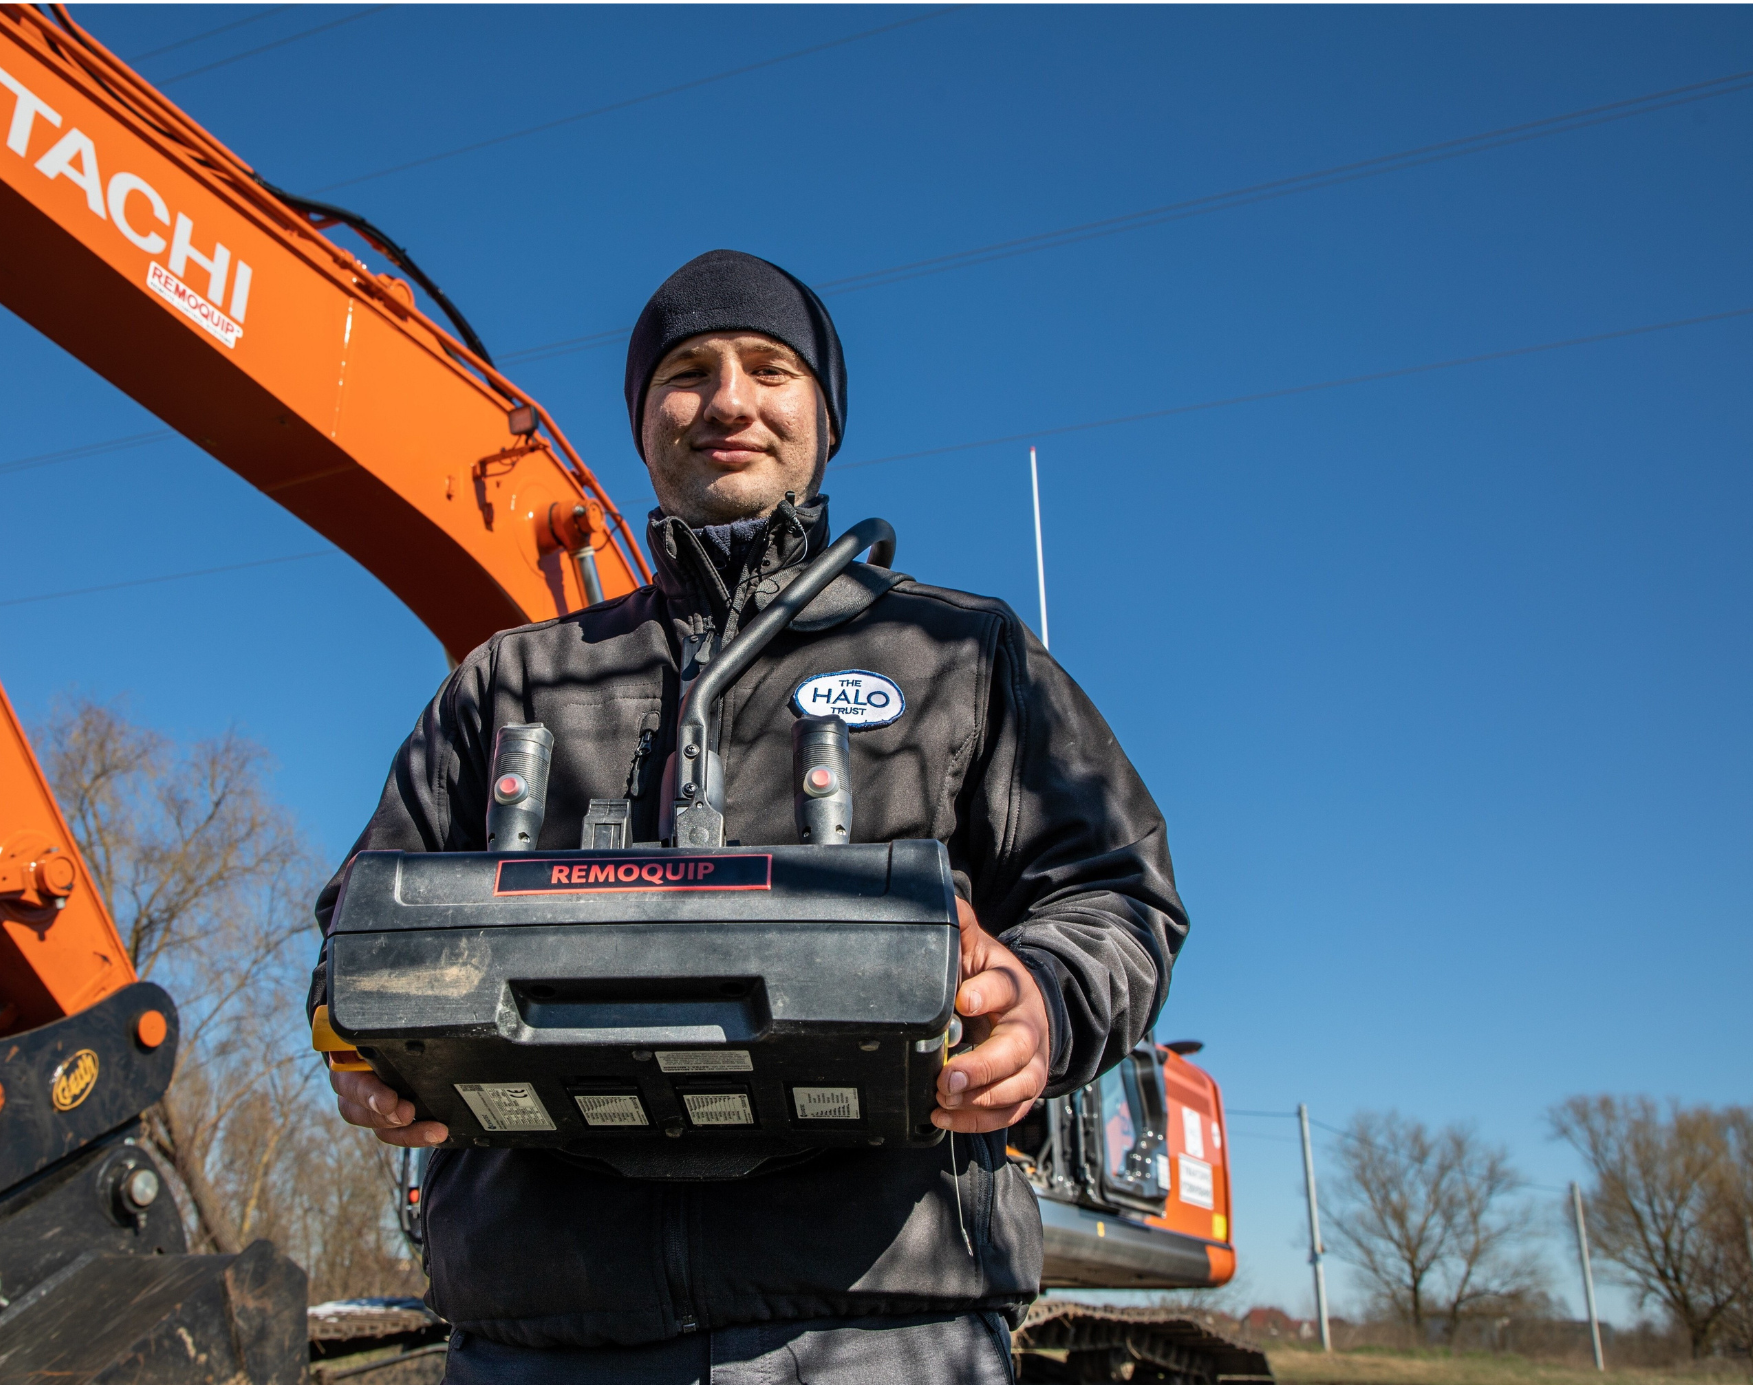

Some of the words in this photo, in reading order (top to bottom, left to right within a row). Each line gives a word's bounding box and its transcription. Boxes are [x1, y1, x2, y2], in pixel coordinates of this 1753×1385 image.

[152, 266, 234, 335] REMOQUIP
[839, 679, 862, 687] THE
[812, 687, 890, 708] HALO
[830, 706, 867, 715] TRUST
[551, 862, 715, 885] REMOQUIP
